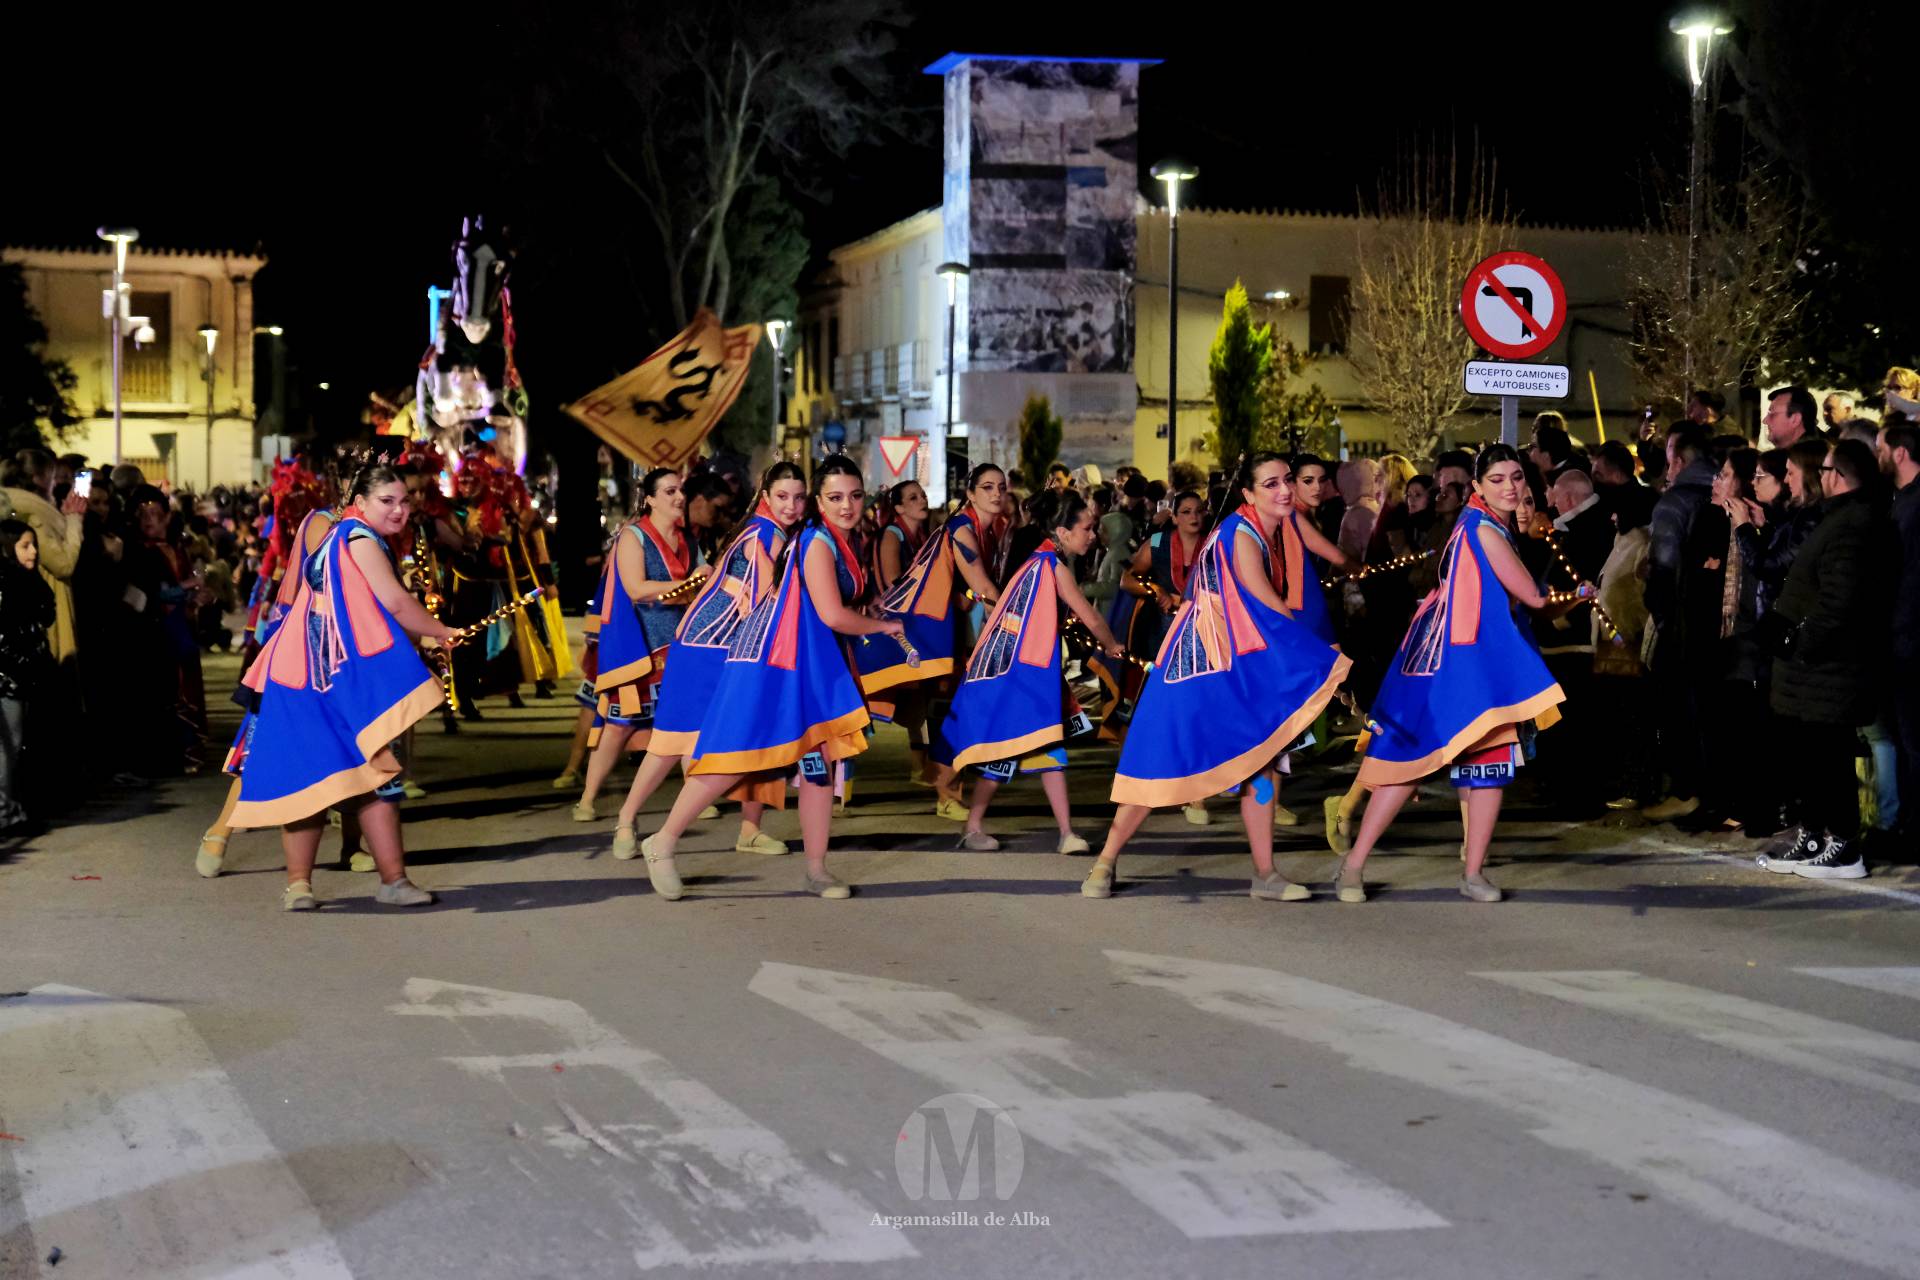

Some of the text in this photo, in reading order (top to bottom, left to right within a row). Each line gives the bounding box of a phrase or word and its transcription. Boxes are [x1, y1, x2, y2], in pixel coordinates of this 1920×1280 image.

[1468, 367, 1567, 381] EXCEPTO CAMIONES
[1483, 380, 1551, 391] Y AUTOBUSES
